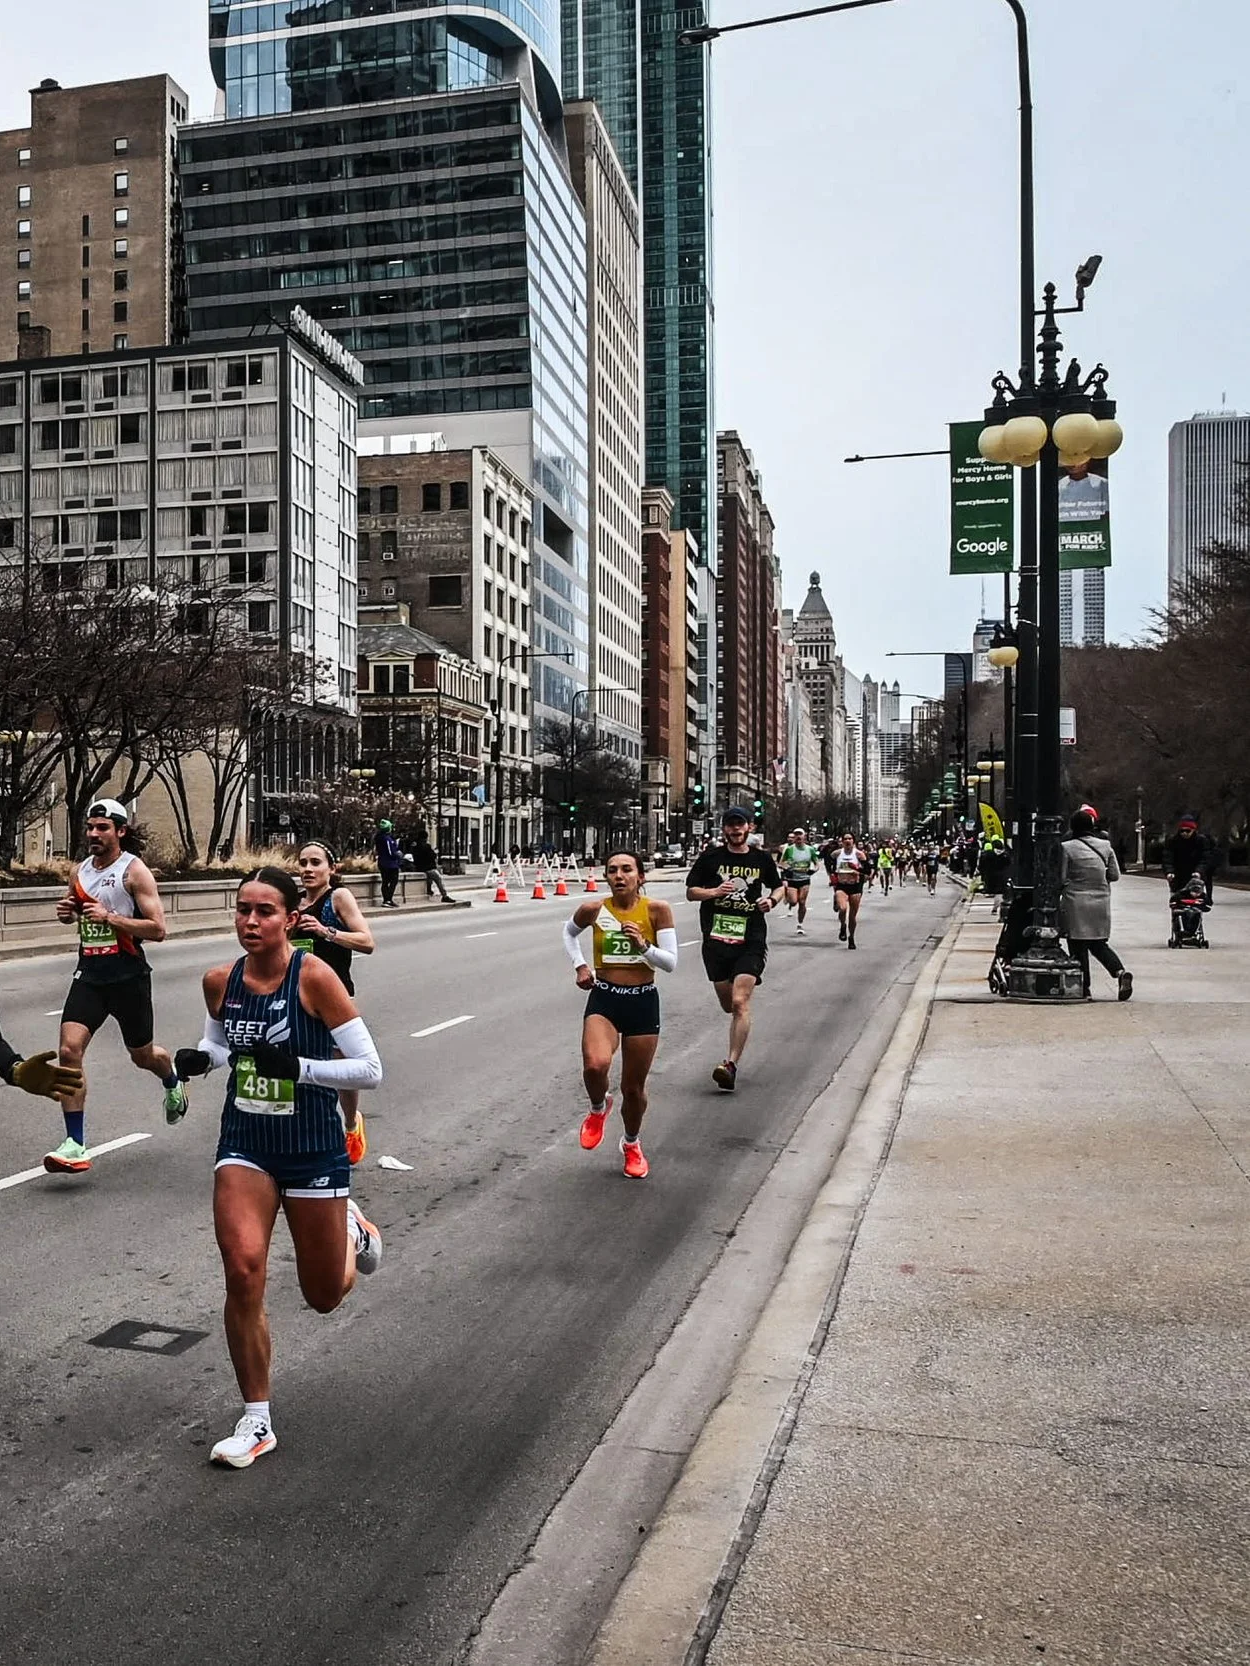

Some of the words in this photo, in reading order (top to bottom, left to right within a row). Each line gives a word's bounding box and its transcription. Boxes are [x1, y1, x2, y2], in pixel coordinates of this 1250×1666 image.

[965, 475, 985, 483] Boys
[1061, 533, 1103, 545] MARCH
[956, 536, 1008, 556] Google
[717, 864, 760, 879] ALBION
[612, 941, 631, 954] 29
[611, 986, 640, 995] NIKE
[224, 1018, 268, 1034] FLEET
[227, 1033, 262, 1046] FEET
[243, 1075, 279, 1099] 481
